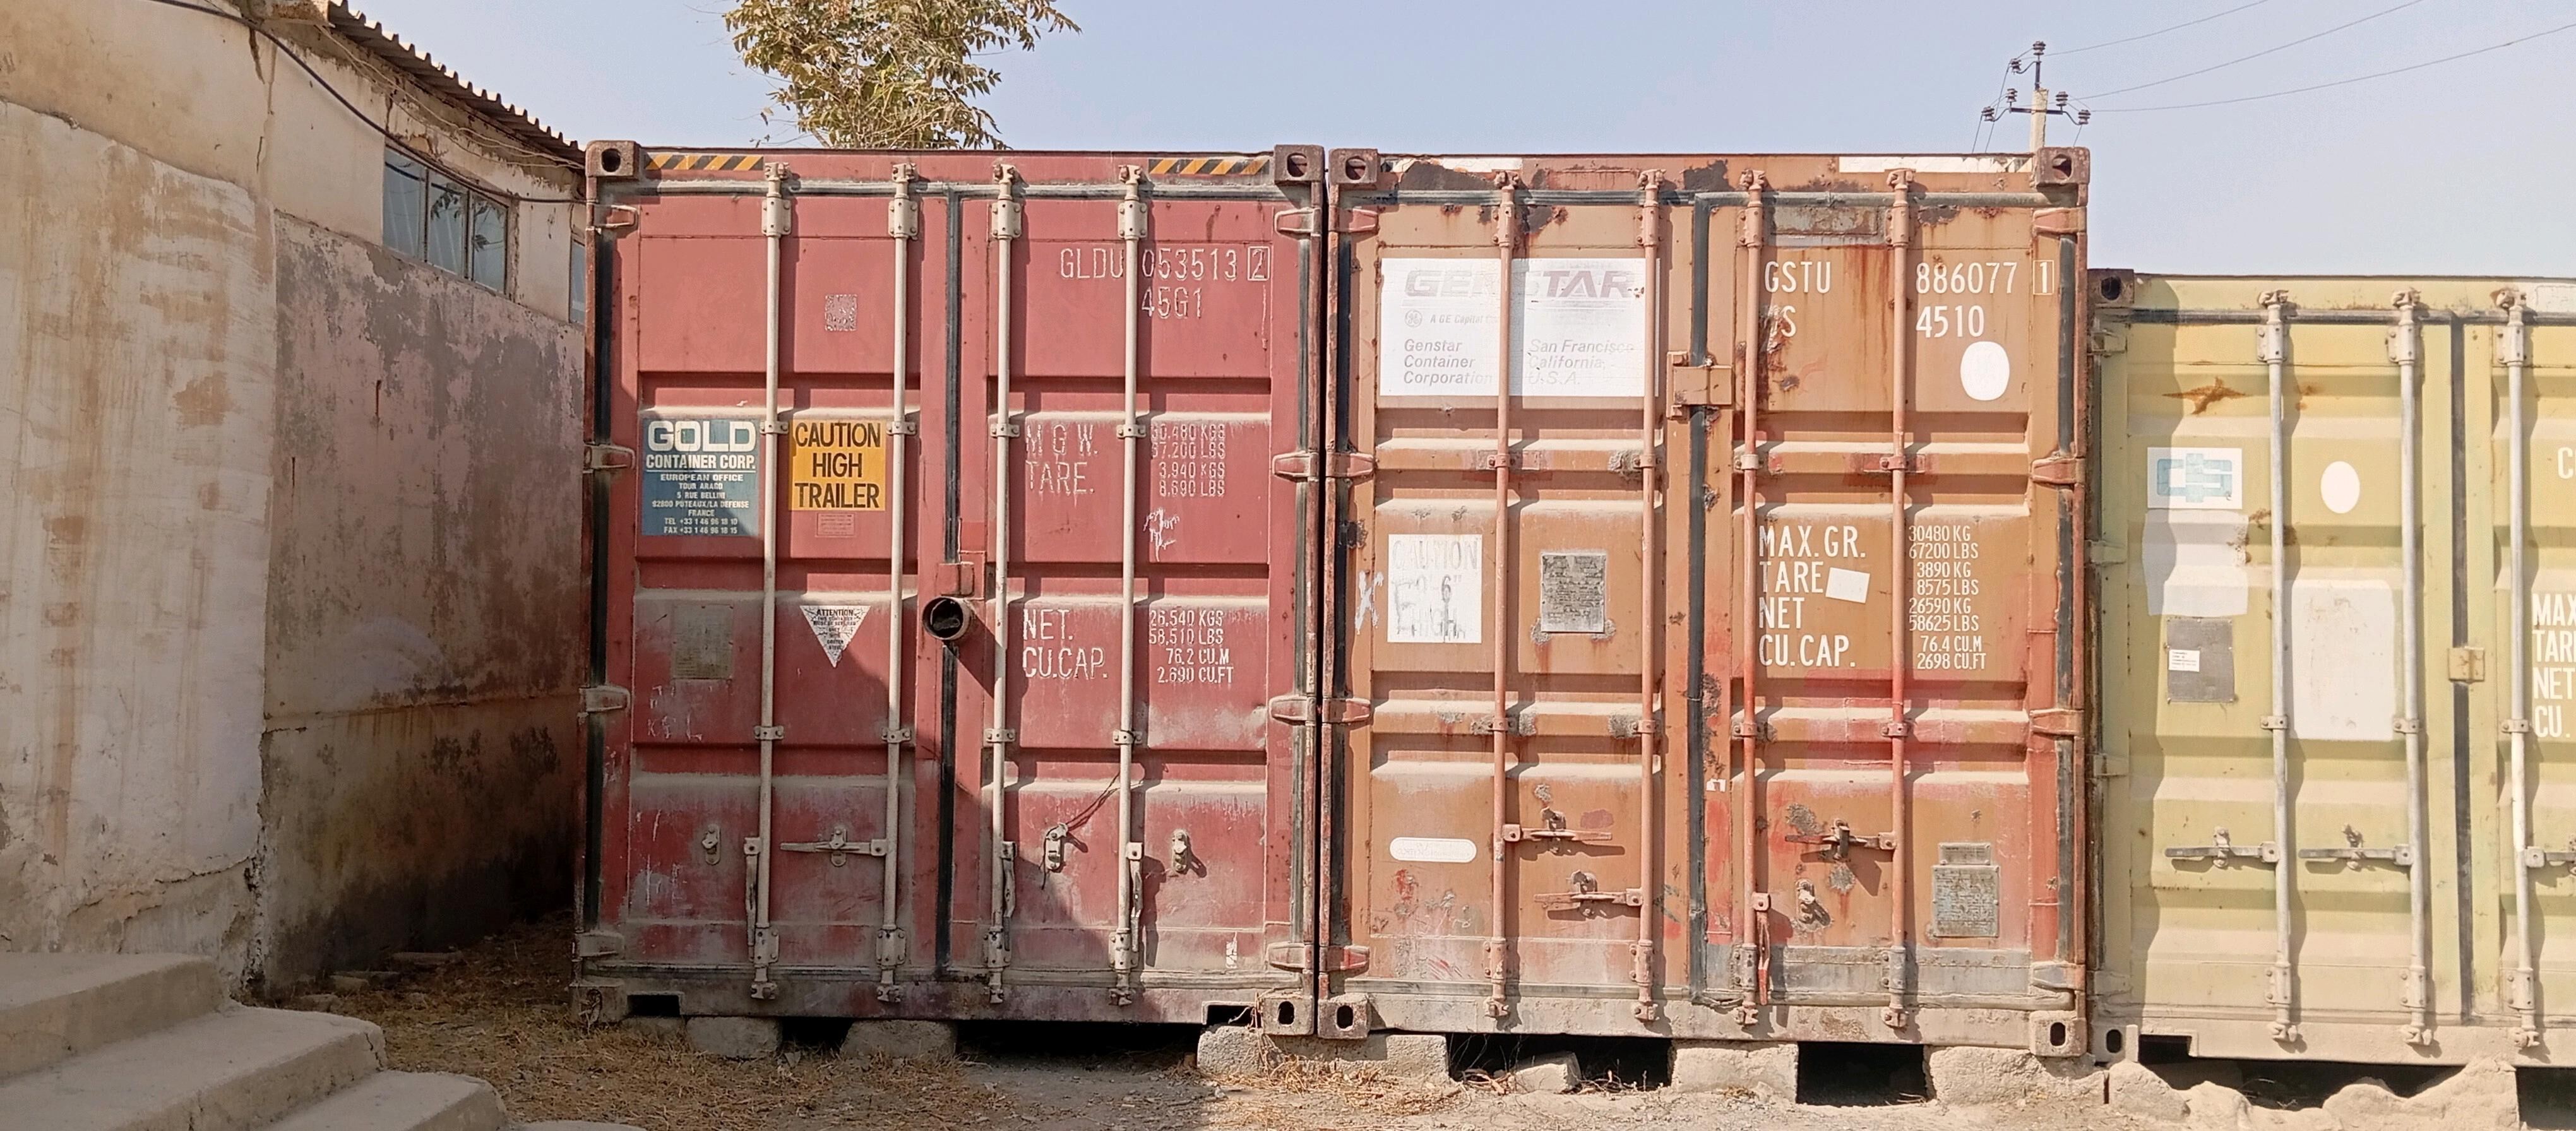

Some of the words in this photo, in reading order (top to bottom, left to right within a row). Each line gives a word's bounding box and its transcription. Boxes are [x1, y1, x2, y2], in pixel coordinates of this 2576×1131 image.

[1060, 248, 1124, 279] GLDU
[1142, 248, 1237, 281] 053513
[1251, 249, 1265, 279] 2
[1765, 261, 1831, 294] GSTU
[1916, 261, 2017, 294] 886077
[2039, 262, 2048, 293] 1
[1142, 287, 1202, 319] 45G1
[1430, 315, 1436, 323] A
[1440, 315, 1452, 323] GE
[1916, 305, 1985, 338] 4510
[1404, 338, 1462, 352] Genstar
[1529, 339, 1557, 353] San
[1404, 355, 1476, 368] Container
[1404, 370, 1493, 386] Corporation
[648, 420, 756, 452] GOLD
[795, 422, 880, 447] CAUTION
[1201, 423, 1225, 441] KGS
[1201, 442, 1225, 459] LBS
[646, 454, 717, 469] CONTAINER
[720, 454, 756, 469] CORP.
[813, 453, 862, 478] HIGH
[1201, 461, 1225, 478] KGS
[2557, 447, 2576, 480] C
[795, 483, 880, 508] TRAILER
[1201, 480, 1225, 497] LBS
[1909, 525, 1950, 542] 30480
[1953, 525, 1971, 542] KG
[1909, 543, 1950, 559] 67200
[1953, 543, 1979, 559] LBS
[1760, 561, 1824, 593] TARE
[1917, 561, 1950, 578] 3890
[1953, 561, 1971, 578] KG
[1917, 579, 1951, 596] 8575
[1953, 579, 1979, 596] LBS
[1759, 597, 1805, 629] NET
[1909, 597, 1950, 614] 26590
[1953, 597, 1971, 614] KG
[1023, 609, 1073, 641] NET.
[1198, 610, 1224, 627] KGS
[1909, 615, 1951, 632] 58625
[1953, 615, 1979, 632] LBS
[1198, 628, 1224, 644] LBS
[1921, 636, 1950, 652] 76.4
[1953, 636, 1982, 652] CU.M
[1759, 634, 1856, 667] CU.CAP.
[2532, 630, 2576, 663] TAR
[1023, 647, 1108, 679] CU.CAP.
[1166, 648, 1194, 665] 76.2
[1198, 648, 1229, 665] CU.M
[1917, 653, 1950, 670] 2698
[1953, 653, 1986, 670] CU.FT
[1157, 666, 1195, 683] 2.690
[1198, 666, 1234, 683] CU.FT
[2533, 666, 2576, 700] NET
